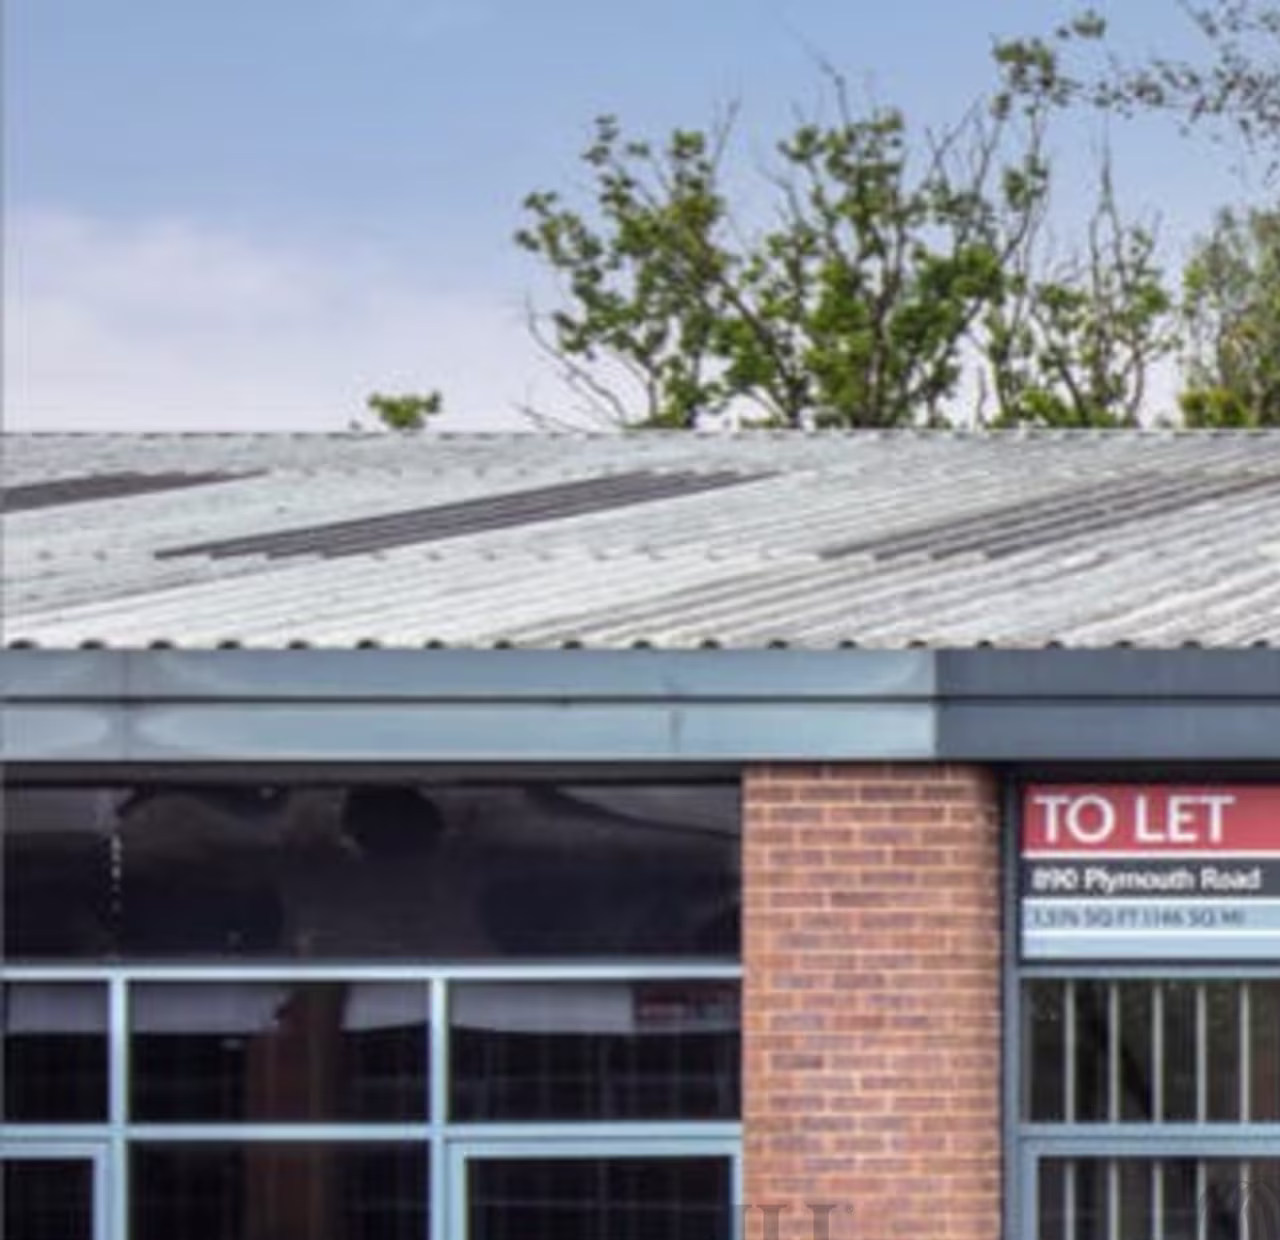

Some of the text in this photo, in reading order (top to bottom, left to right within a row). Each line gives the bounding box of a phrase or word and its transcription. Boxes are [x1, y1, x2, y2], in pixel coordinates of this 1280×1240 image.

[1034, 795, 1236, 843] TO LET
[1032, 866, 1262, 895] 890 Plymouth Road
